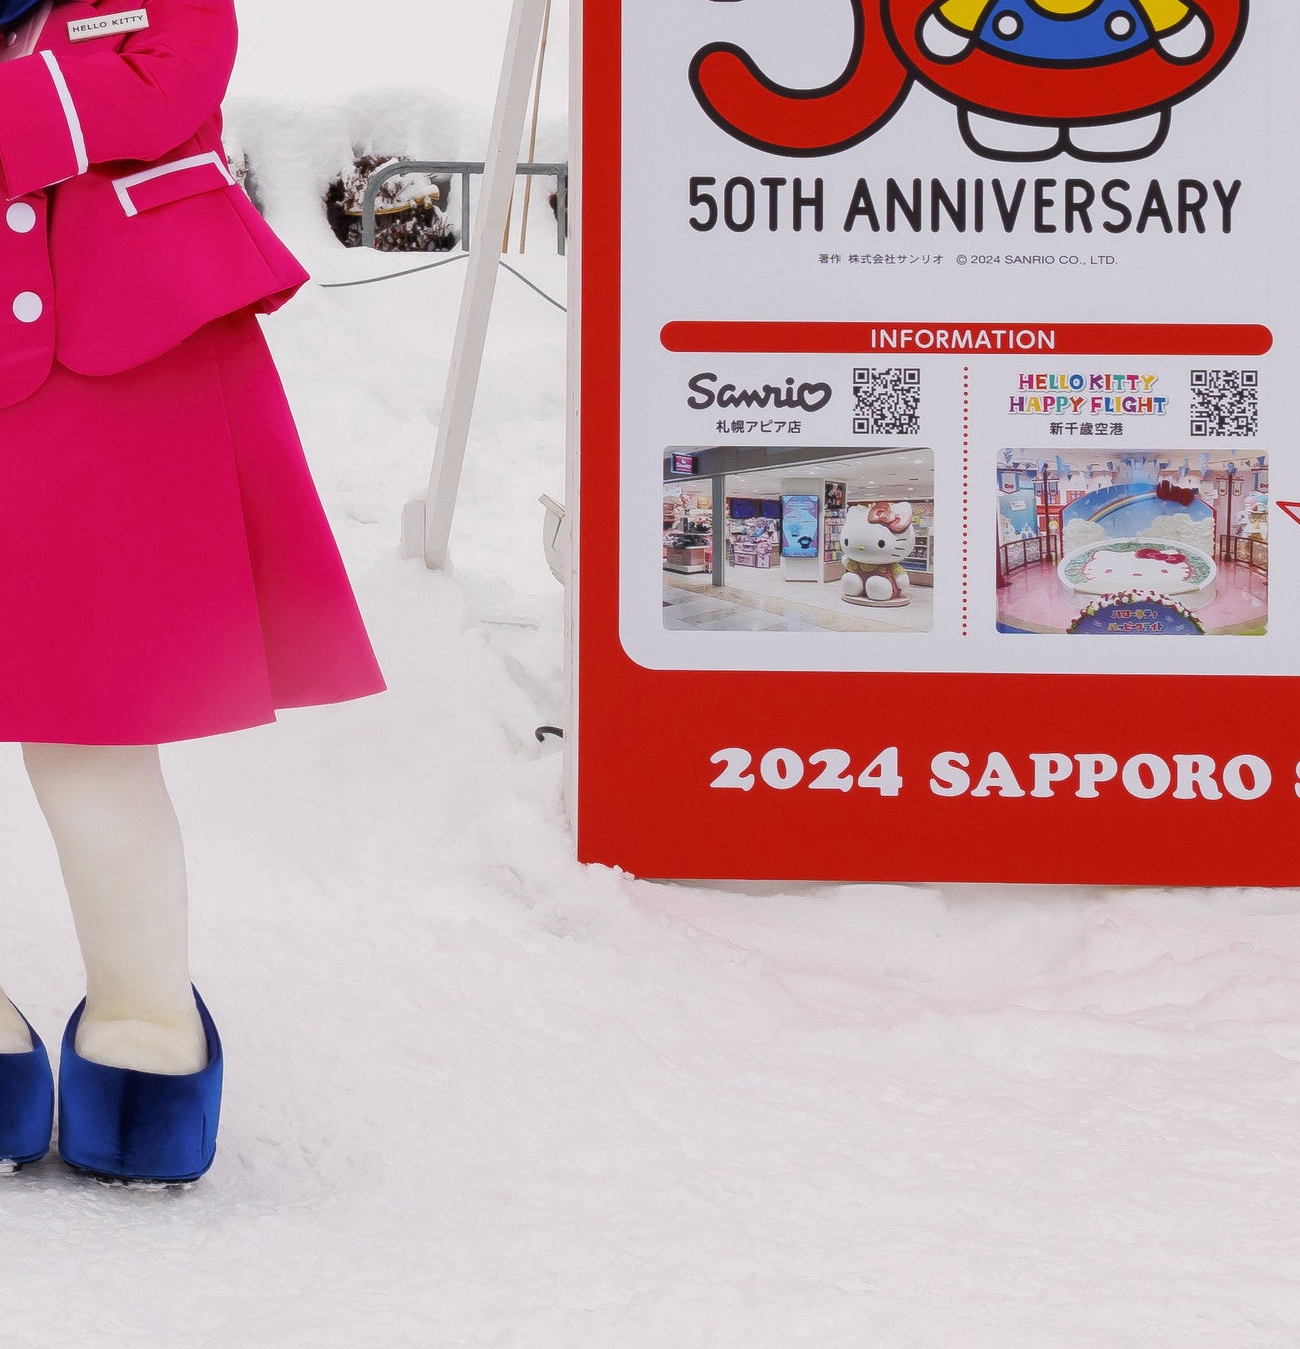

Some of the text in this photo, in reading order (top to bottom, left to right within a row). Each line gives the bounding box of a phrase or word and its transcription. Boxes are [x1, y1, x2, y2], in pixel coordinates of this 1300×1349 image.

[72, 15, 144, 33] HELLO KITTY
[688, 176, 1243, 235] 50TH ANNIVERSARY
[818, 253, 842, 265] 著作
[848, 253, 945, 265] 株式会社サンリオ
[970, 254, 1002, 265] 2024
[1004, 254, 1056, 266] SANRIO
[1090, 255, 1120, 266] LTD.
[870, 328, 1055, 350] INFORMATION
[1017, 372, 1158, 392] HELLO KITTY
[686, 372, 833, 413] Sanrio
[1008, 395, 1168, 415] HAPPY FLIGHT
[716, 418, 802, 434] 札幌アピア店
[1049, 421, 1124, 436] 新千歳空港
[709, 746, 903, 797] 2024
[929, 751, 1272, 801] SAPPORO
